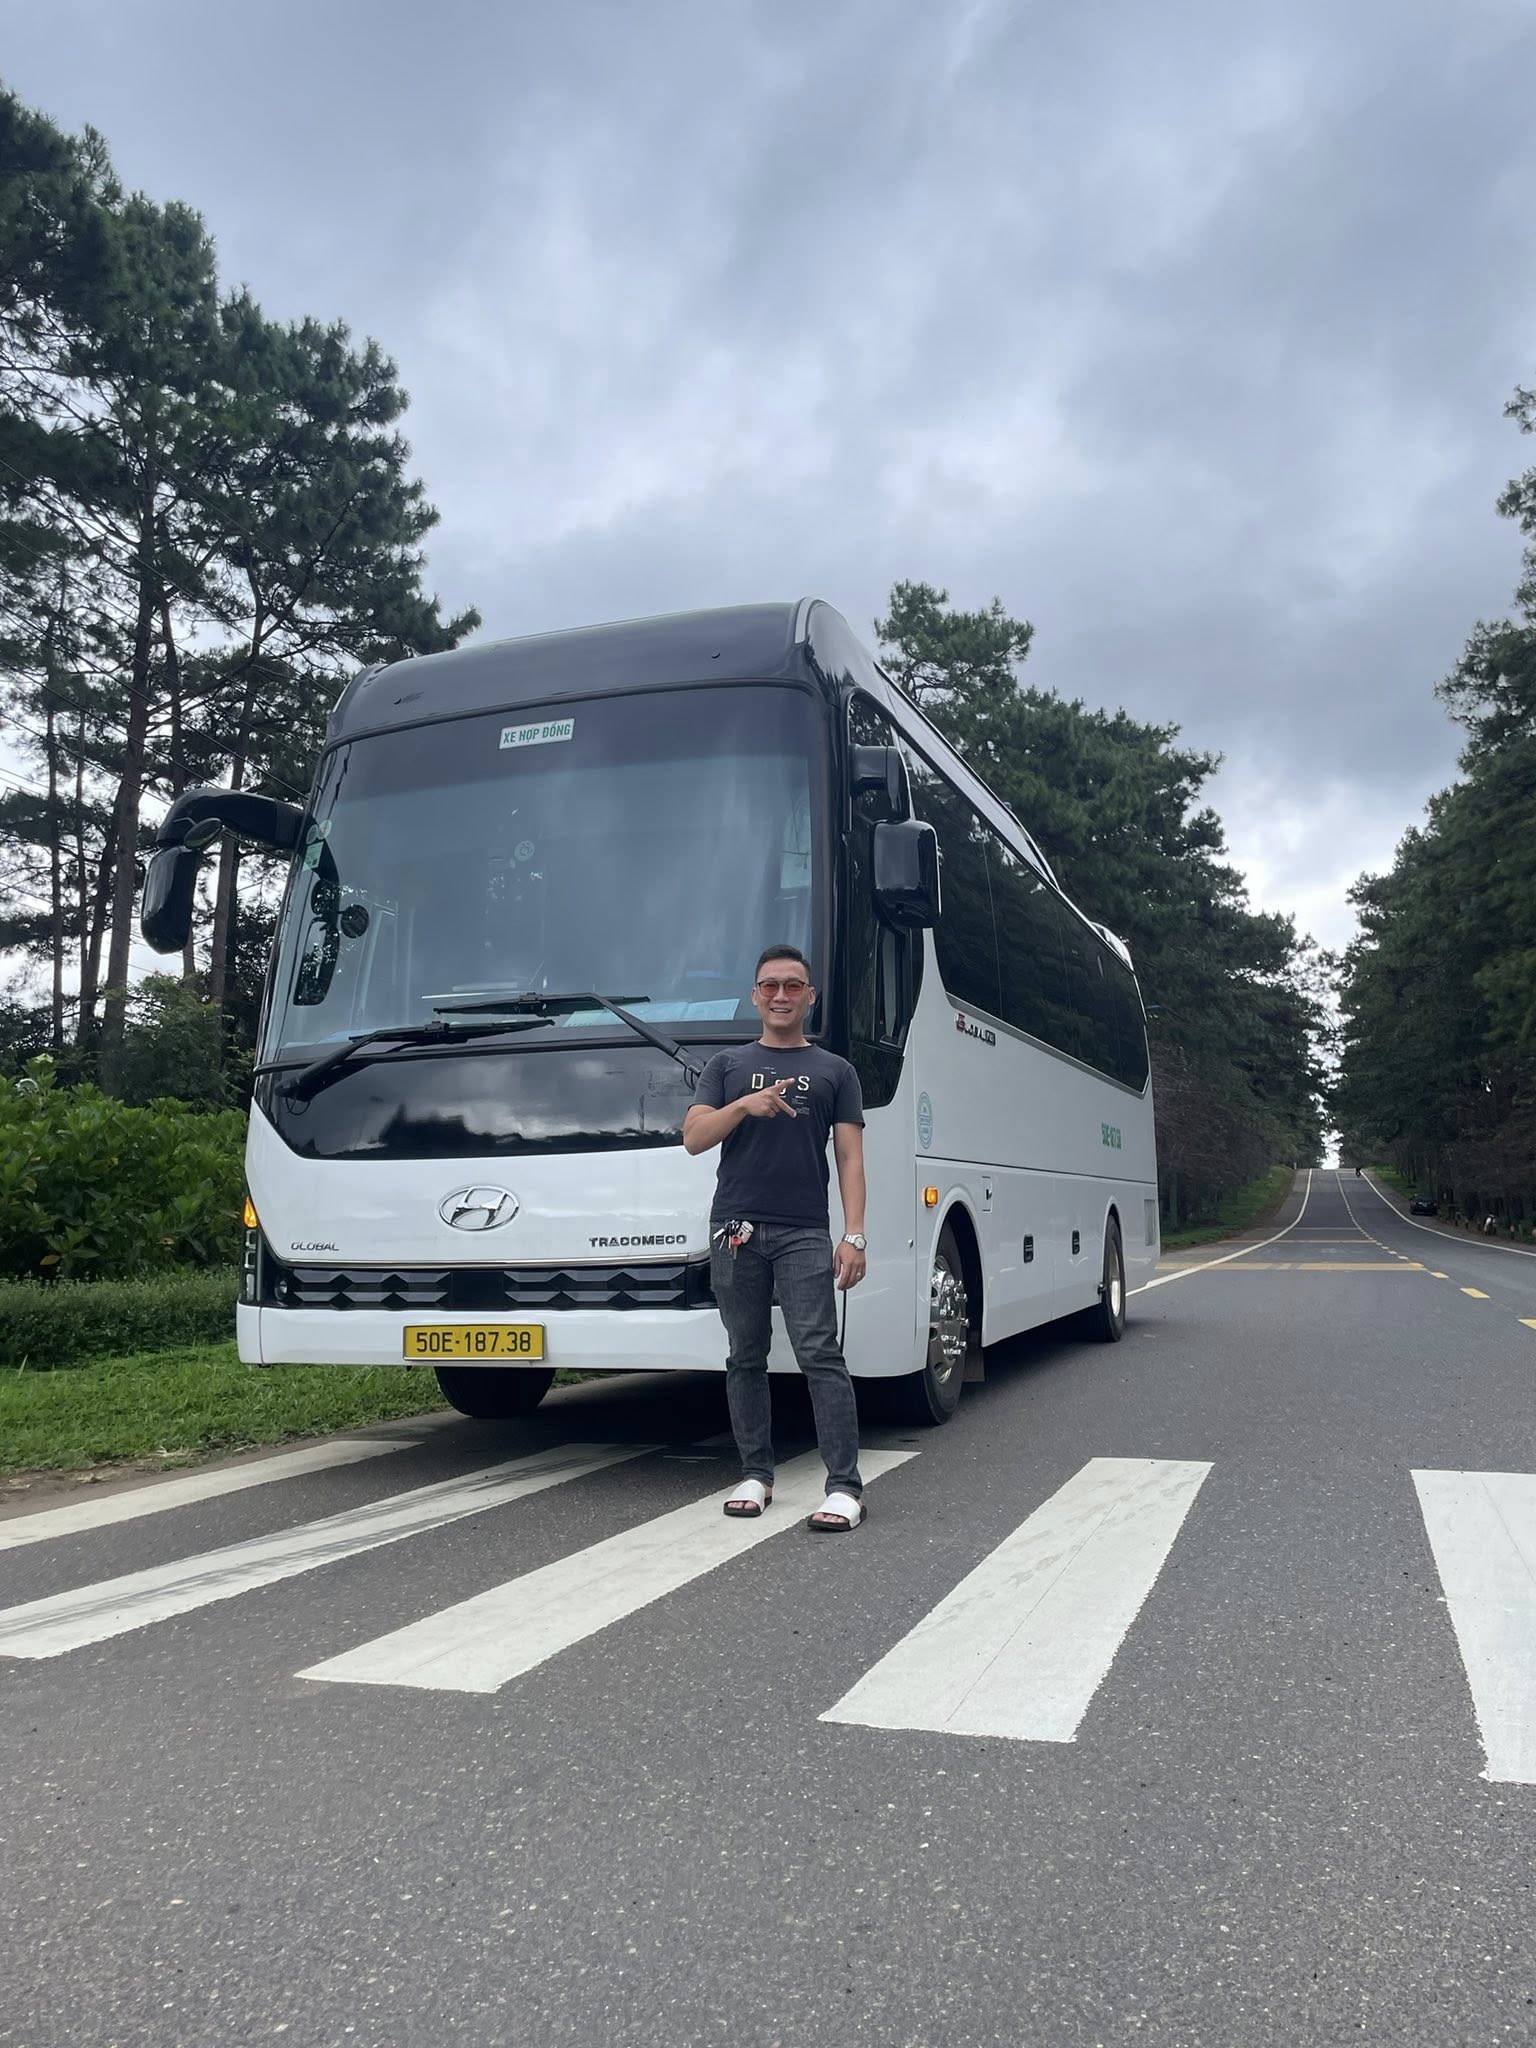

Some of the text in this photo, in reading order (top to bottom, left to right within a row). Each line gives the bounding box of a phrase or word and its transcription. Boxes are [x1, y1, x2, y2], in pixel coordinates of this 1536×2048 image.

[503, 731, 517, 744] XE
[290, 1241, 340, 1251] GLOBAL
[589, 1234, 687, 1248] TRACOMECO
[416, 1331, 532, 1353] 50E-187.38
